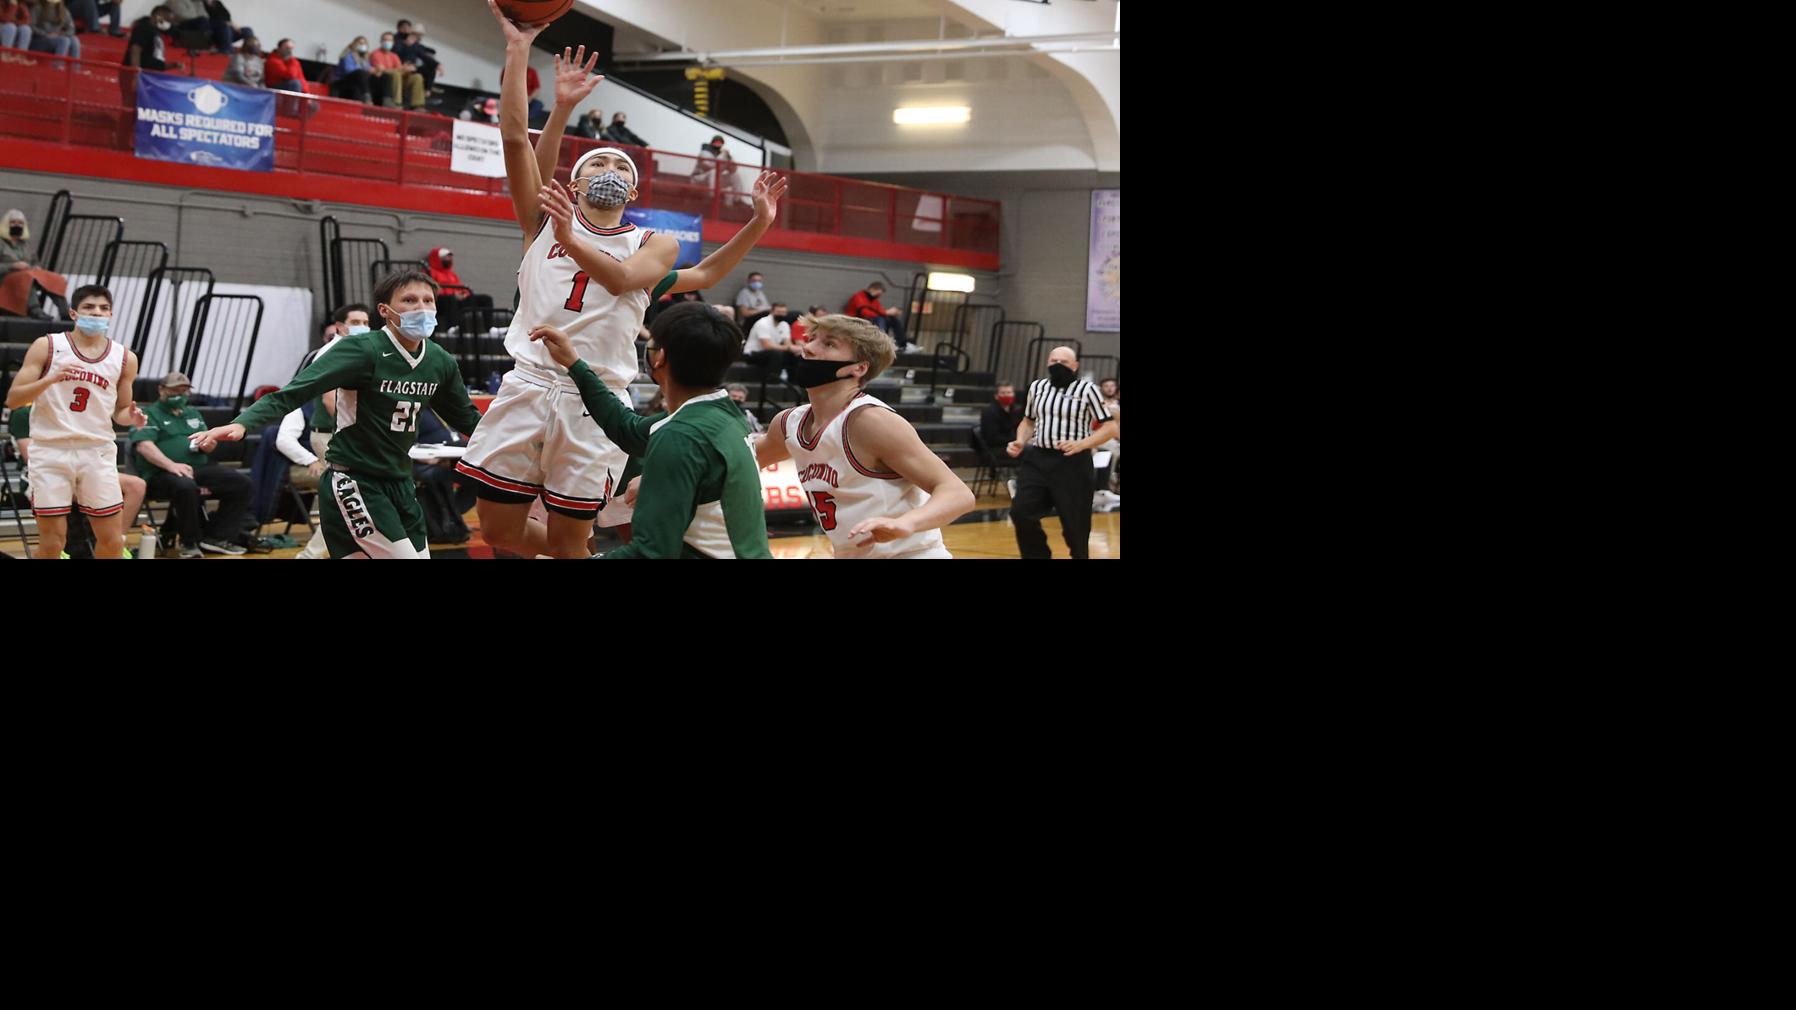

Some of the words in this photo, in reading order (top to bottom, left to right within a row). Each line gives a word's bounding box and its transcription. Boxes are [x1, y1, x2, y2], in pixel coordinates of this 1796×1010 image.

[137, 107, 183, 126] MASKS
[184, 114, 247, 134] REQUIRED
[247, 122, 274, 137] FOR
[150, 124, 178, 140] ALL
[178, 127, 260, 150] SPECTATORS
[564, 270, 589, 313] 1
[69, 386, 90, 412] 3
[390, 400, 421, 432] 21
[336, 477, 374, 538] EAGLES
[805, 490, 837, 531] 5
